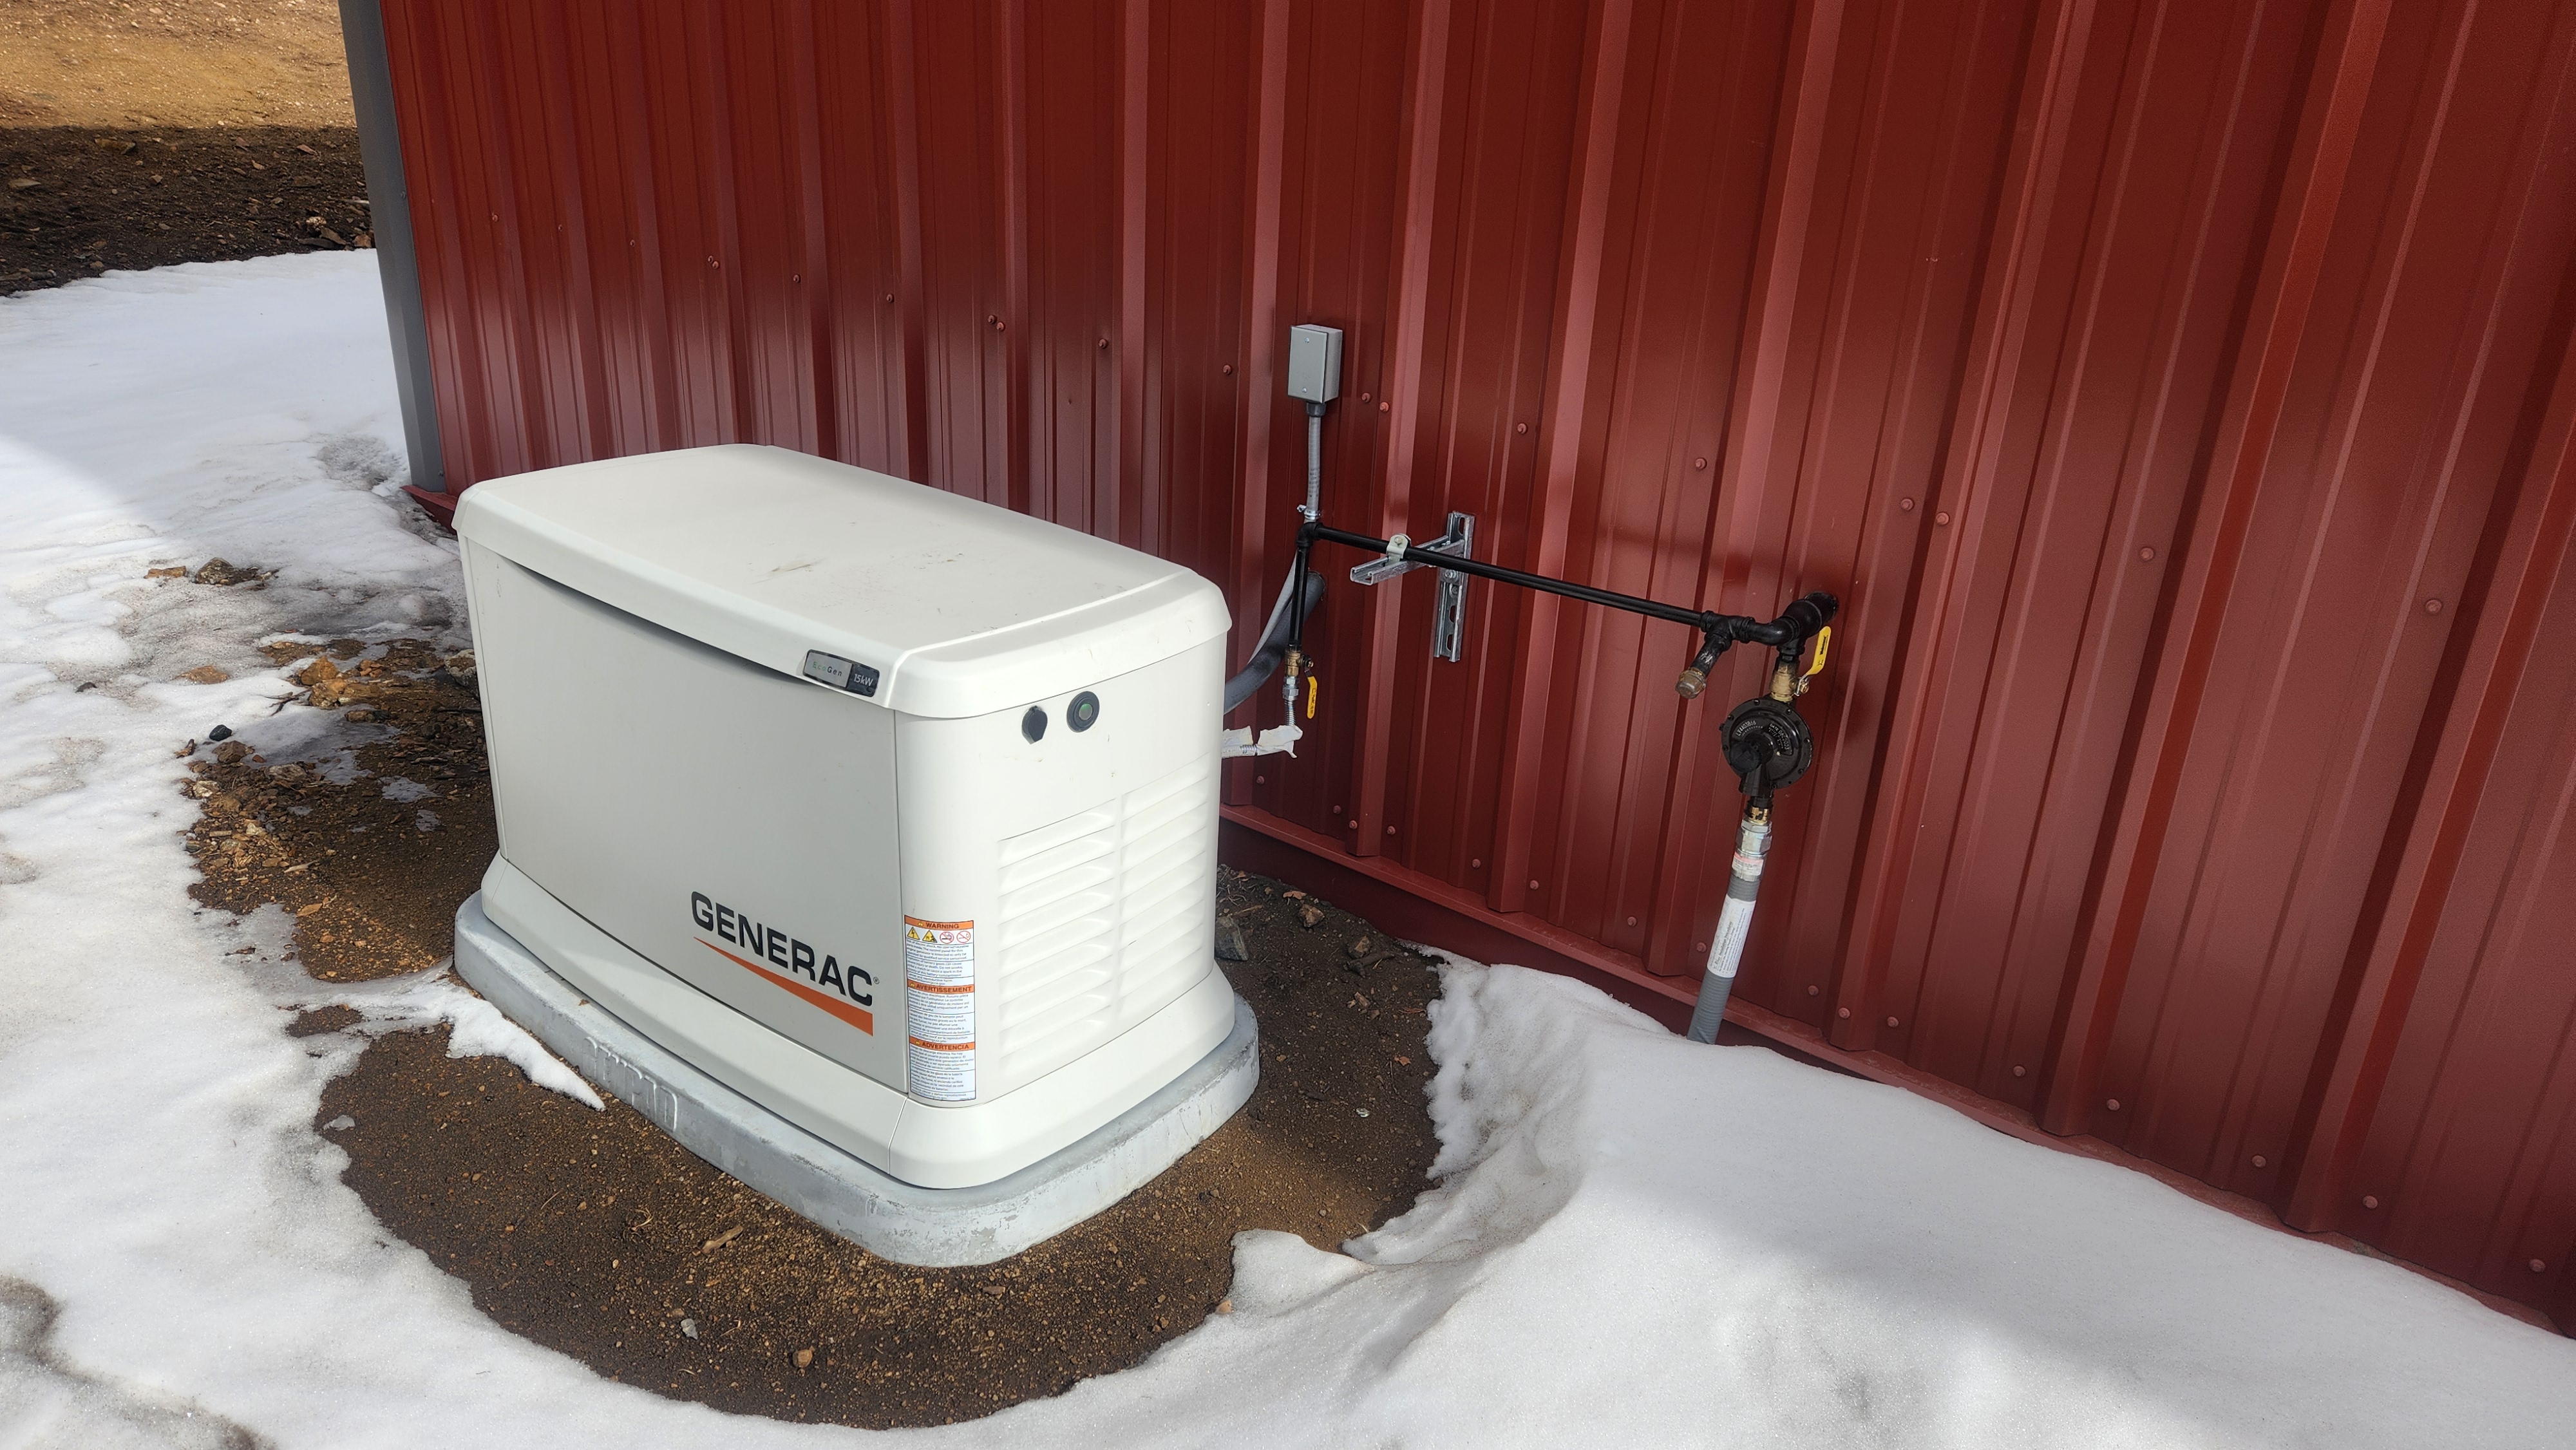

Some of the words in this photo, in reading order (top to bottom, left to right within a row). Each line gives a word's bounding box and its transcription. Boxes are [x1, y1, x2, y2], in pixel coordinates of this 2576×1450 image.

[812, 661, 842, 677] EcoGen
[853, 673, 873, 687] 15kW
[691, 890, 873, 1007] GENERAC
[916, 984, 972, 993] AVERTISSEMENT
[922, 1042, 969, 1050] ADVERTENCIA
